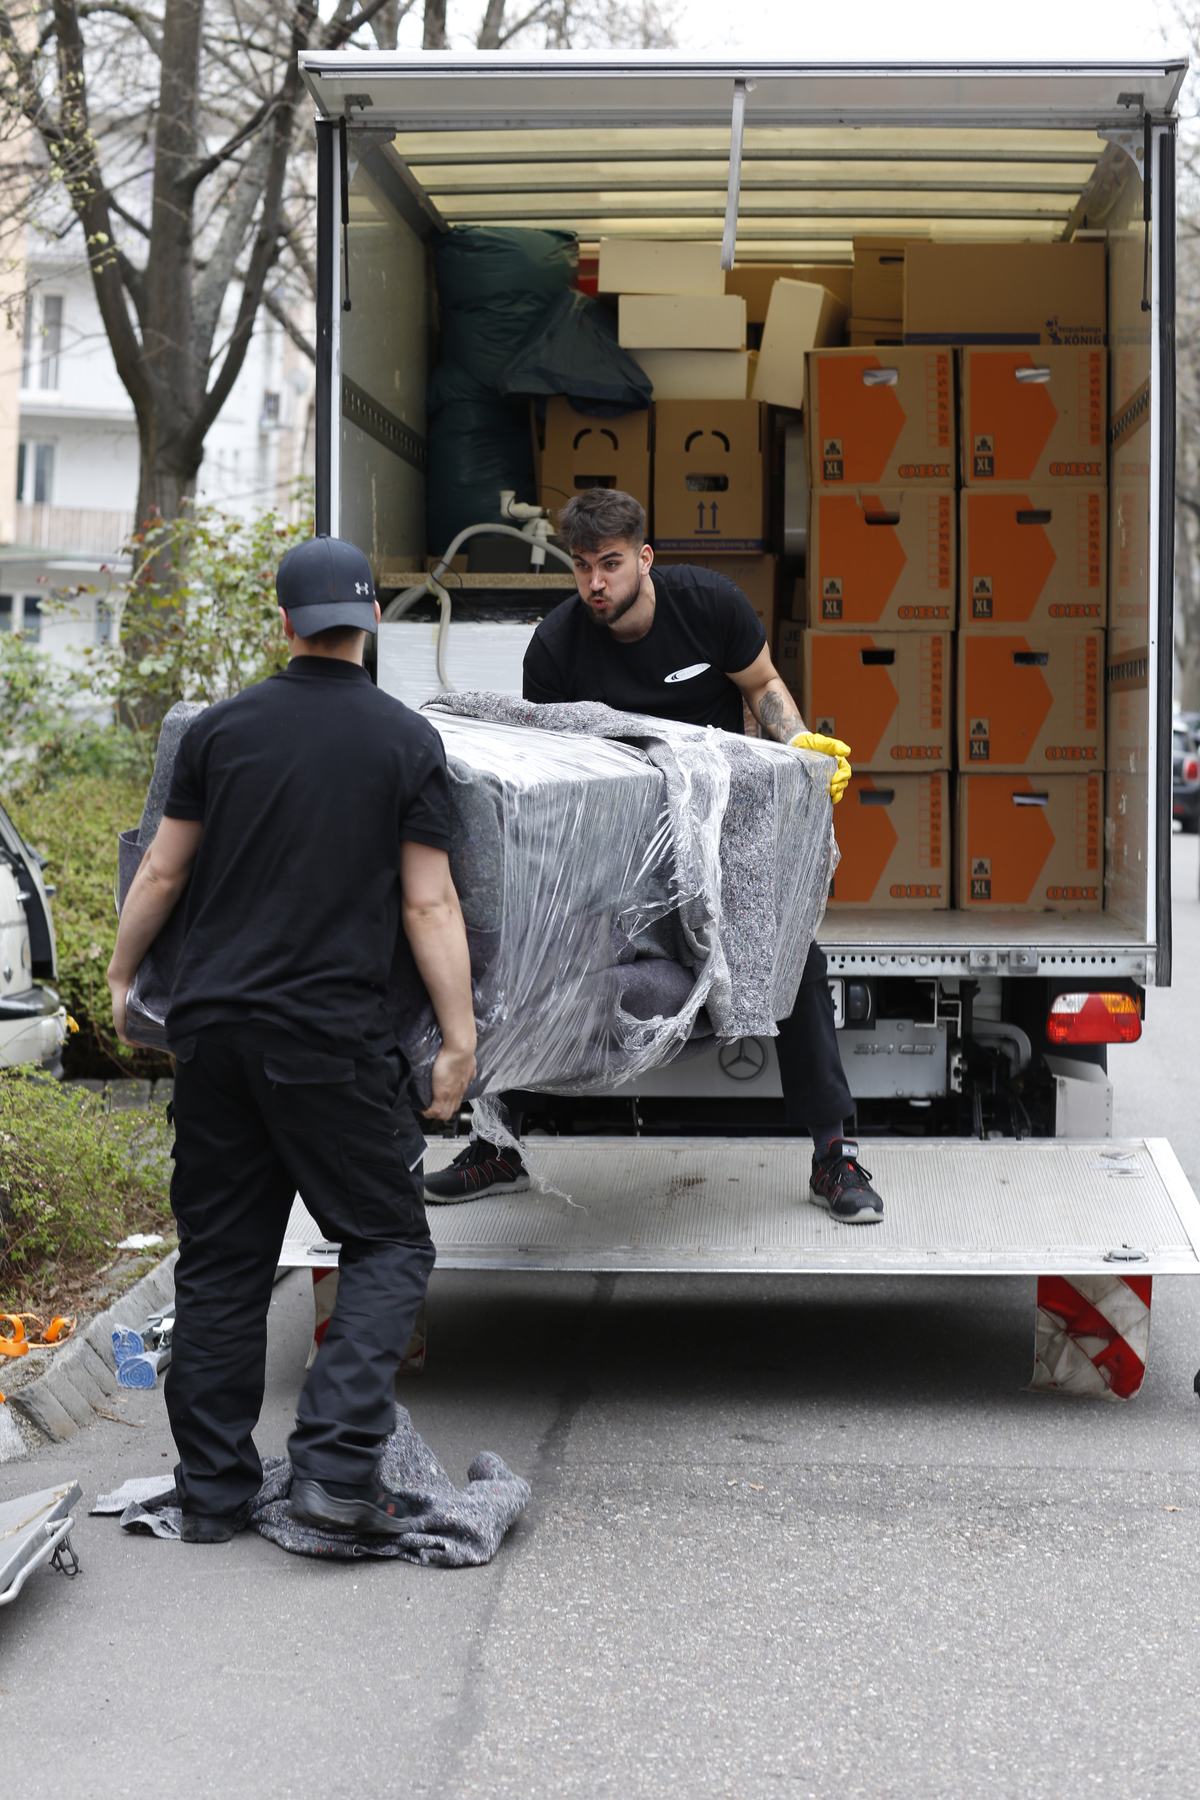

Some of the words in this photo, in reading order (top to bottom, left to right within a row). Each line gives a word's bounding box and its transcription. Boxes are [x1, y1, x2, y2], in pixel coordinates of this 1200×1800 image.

[1064, 334, 1101, 345] KÖNIG
[826, 461, 841, 473] XL
[976, 458, 991, 470] XL
[1049, 462, 1101, 476] OBI
[825, 601, 840, 614] XL
[975, 599, 990, 612] XL
[1048, 603, 1100, 618] OBI
[898, 605, 949, 620] OBI
[890, 745, 942, 760] OBI
[971, 741, 986, 754] XL
[1045, 746, 1097, 761] OBI
[889, 884, 941, 898] OBI
[973, 882, 988, 895] XL
[1046, 885, 1098, 900] OBI
[898, 1043, 936, 1055] CDI
